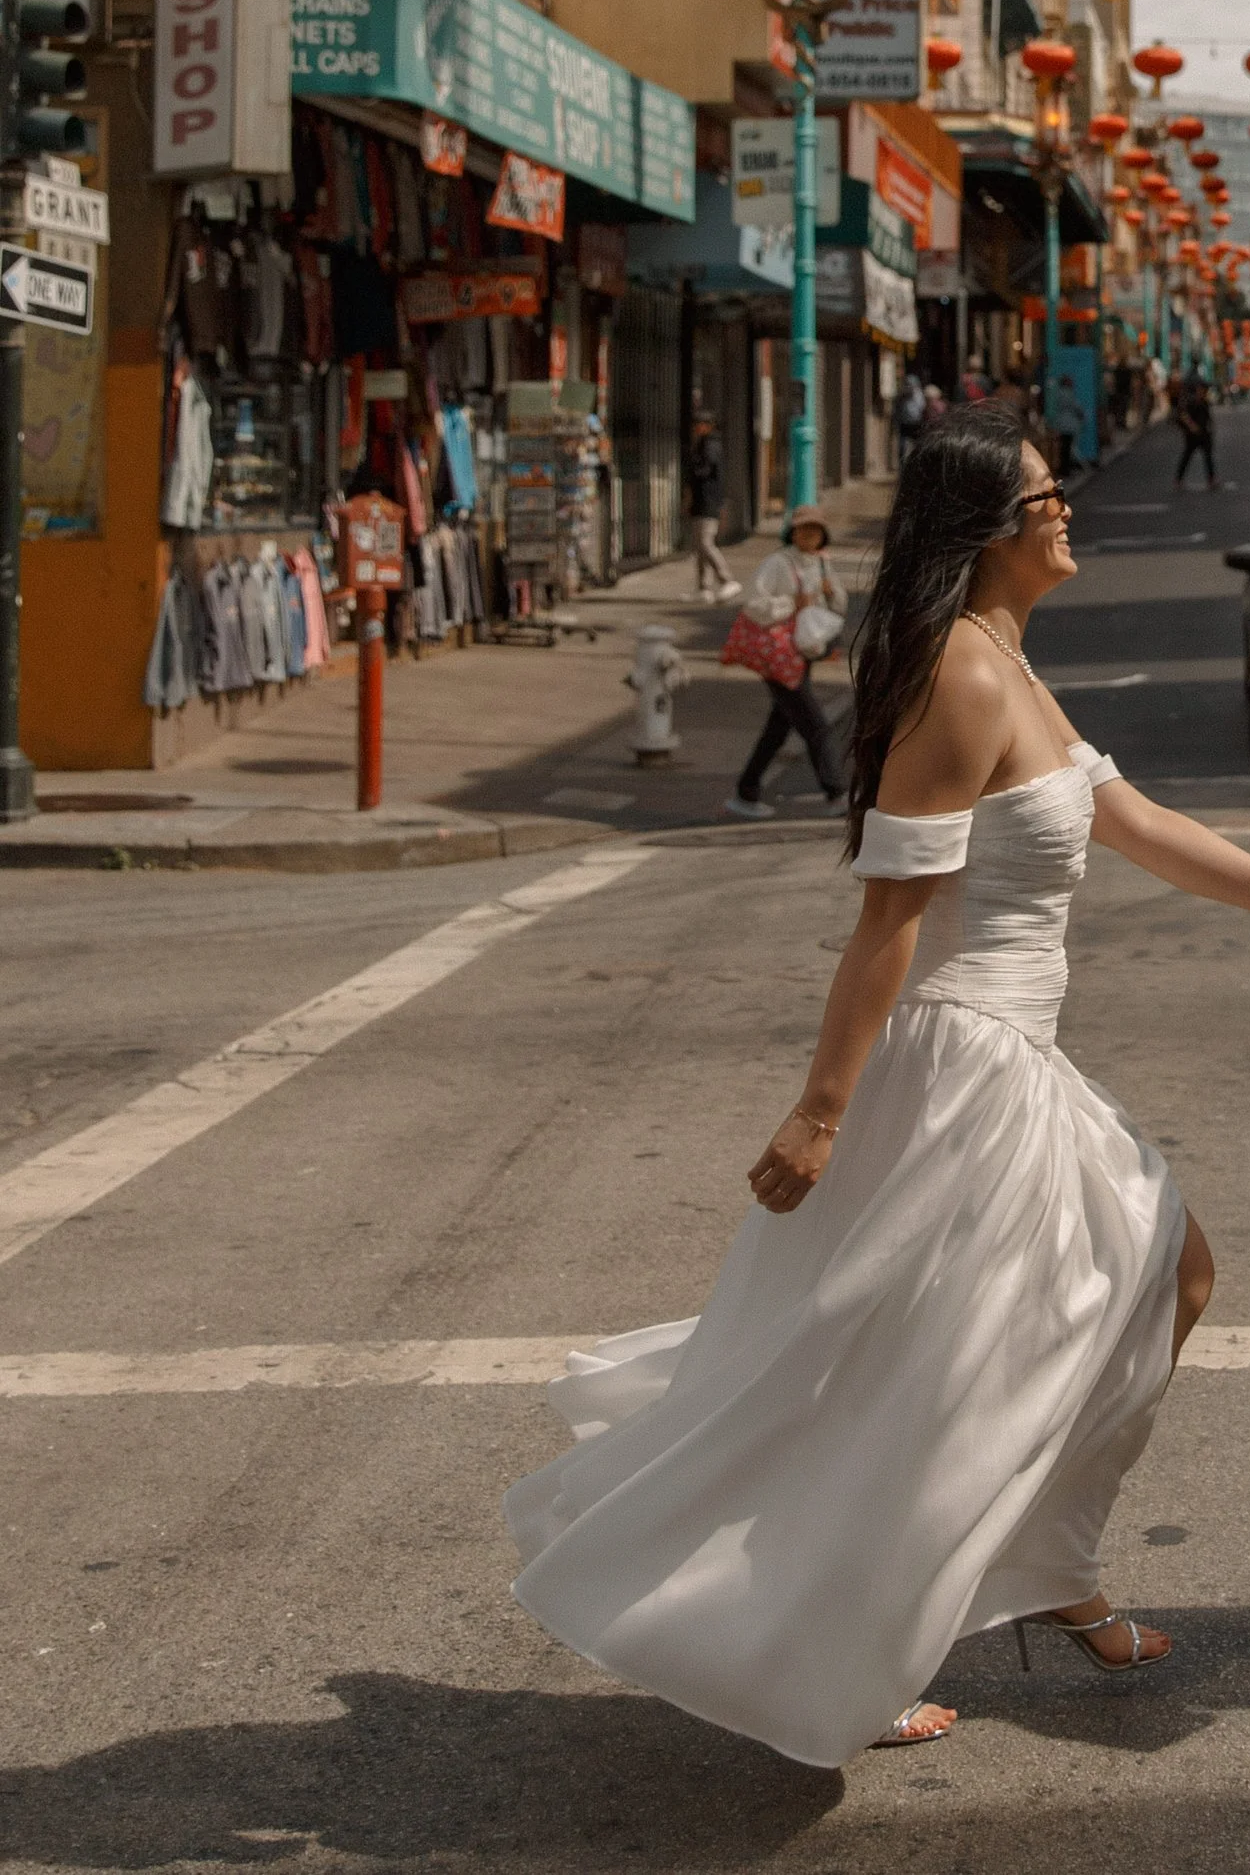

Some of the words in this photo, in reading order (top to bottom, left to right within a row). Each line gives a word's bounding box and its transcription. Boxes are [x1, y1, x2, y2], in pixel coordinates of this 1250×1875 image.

[317, 49, 381, 76] CAPS
[31, 187, 102, 230] GRANT
[28, 275, 51, 303] ONE
[56, 279, 83, 311] WAY
